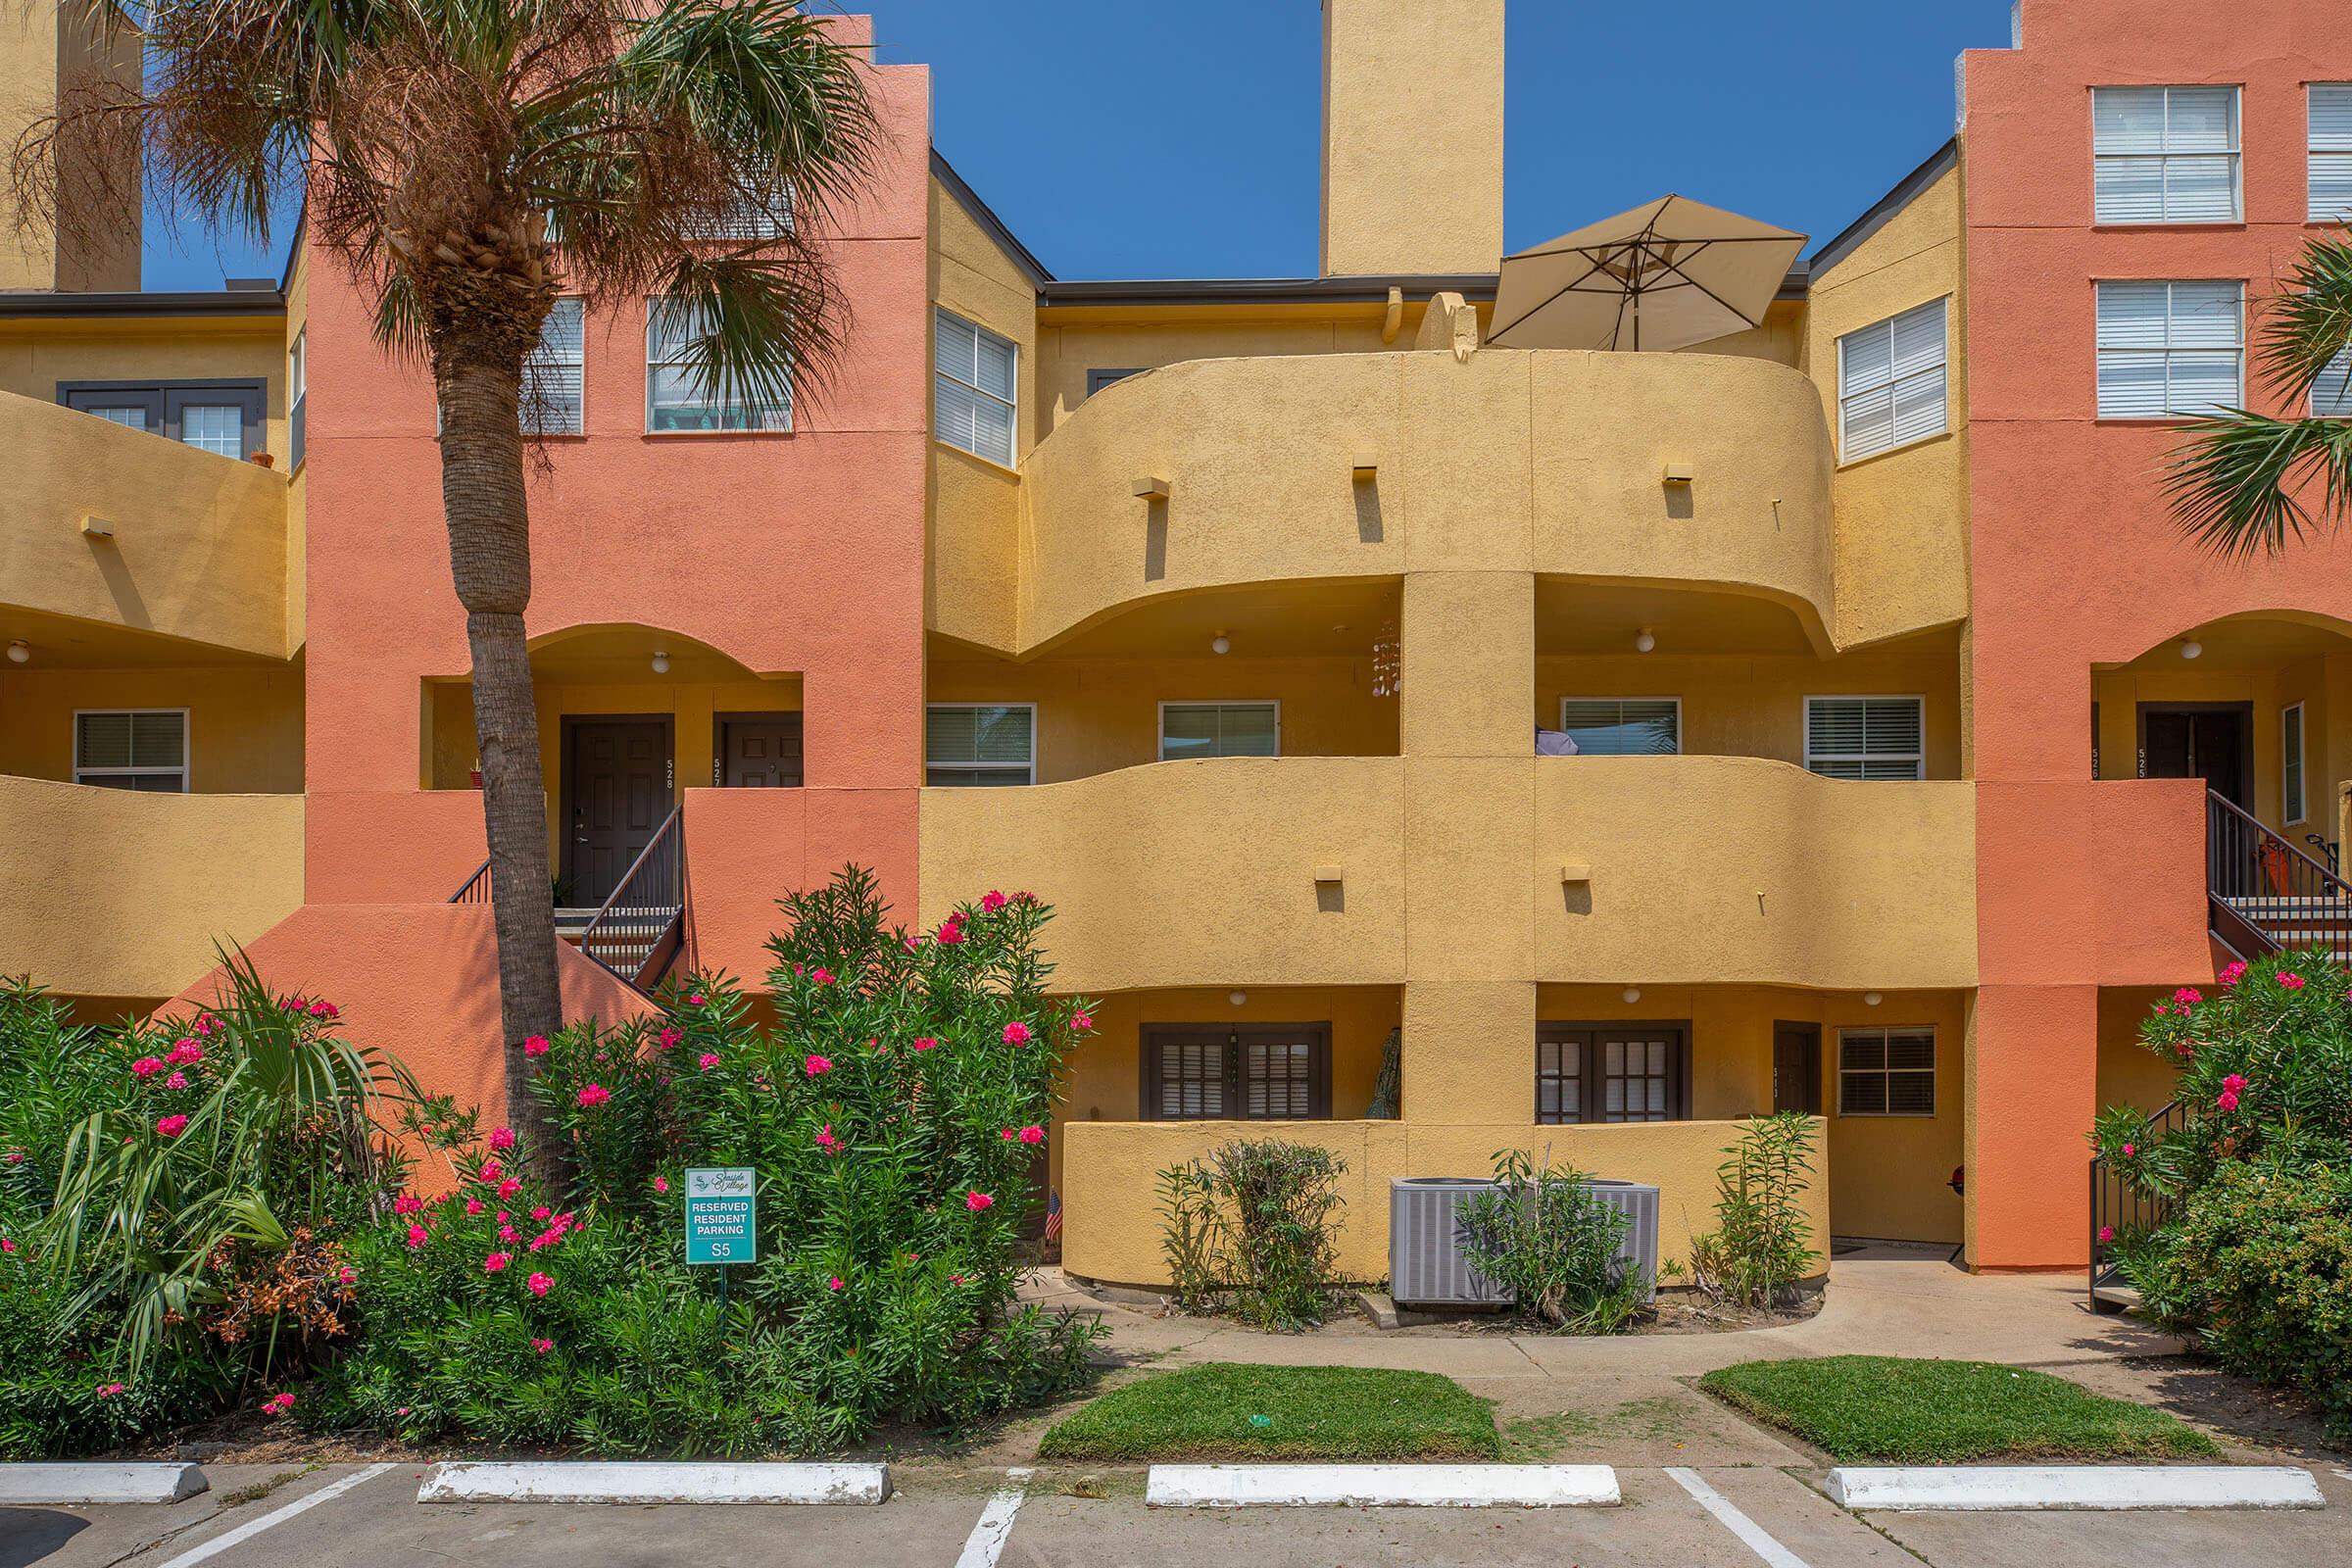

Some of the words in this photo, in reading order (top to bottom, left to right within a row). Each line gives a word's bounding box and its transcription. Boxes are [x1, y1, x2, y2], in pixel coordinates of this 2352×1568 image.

[714, 1181, 749, 1193] Village
[692, 1202, 749, 1212] RESERVED
[694, 1214, 747, 1224] RESIDENT
[697, 1225, 744, 1236] PARKING
[711, 1243, 731, 1256] S5
